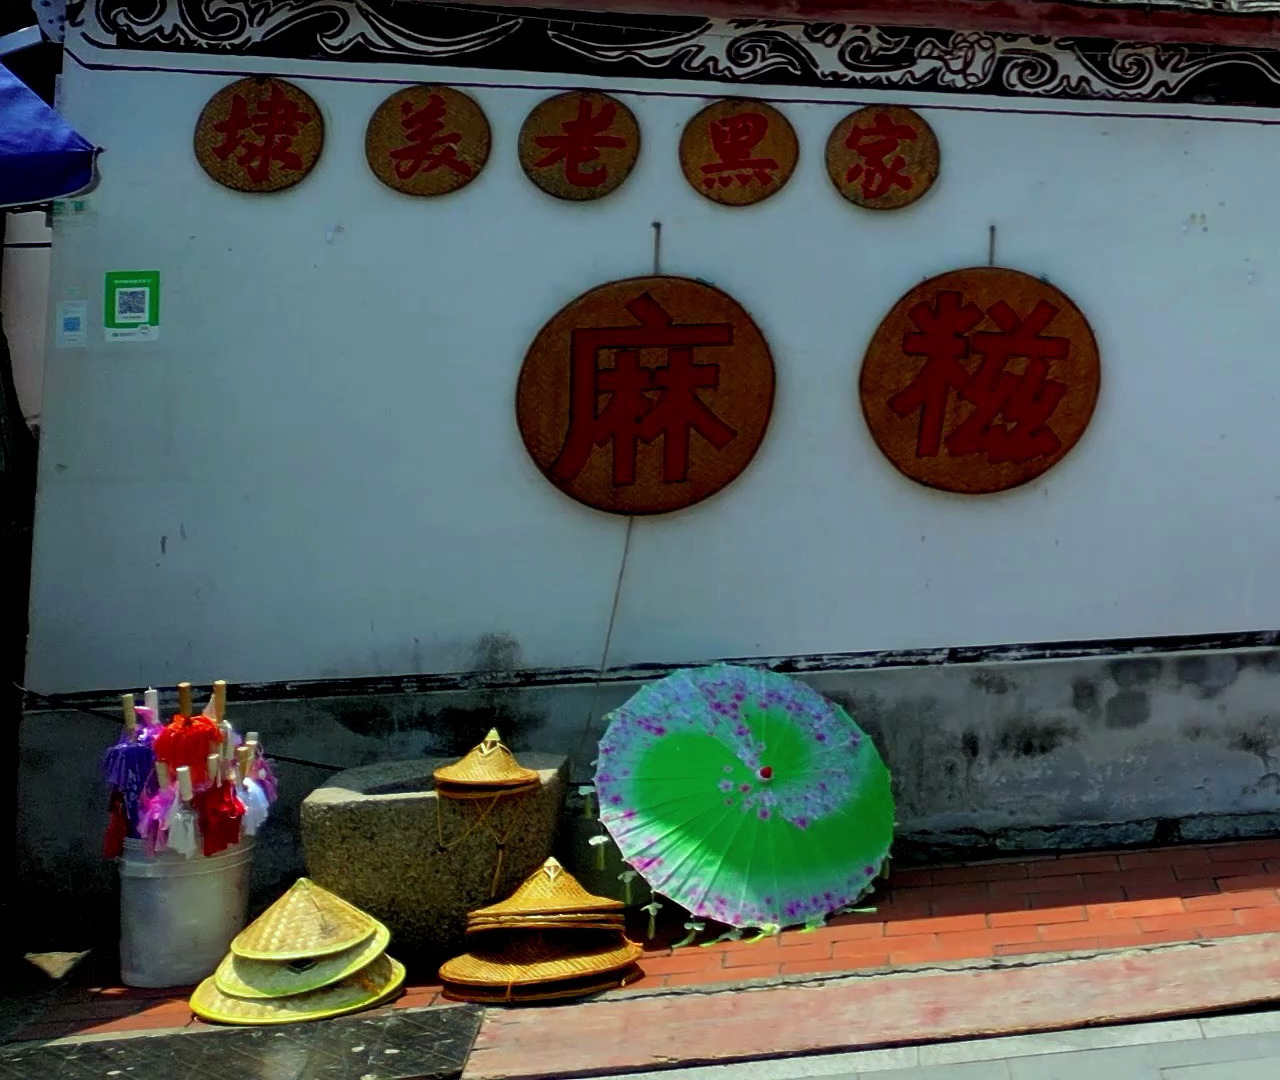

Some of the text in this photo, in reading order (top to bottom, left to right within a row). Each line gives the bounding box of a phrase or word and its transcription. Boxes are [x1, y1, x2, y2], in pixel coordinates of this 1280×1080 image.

[213, 85, 917, 200] 埭美老黑家
[548, 290, 1071, 487] 麻糍
